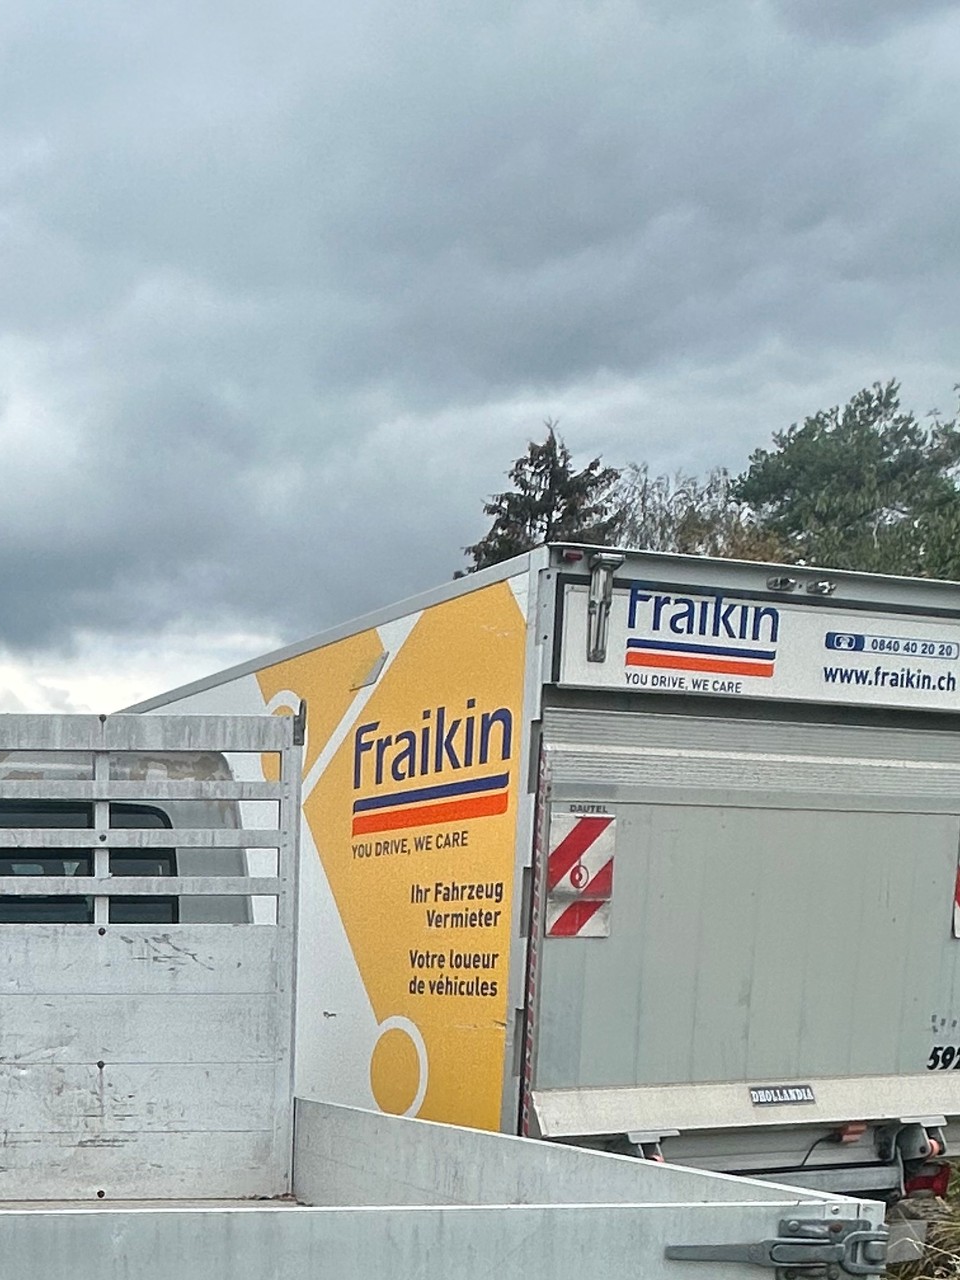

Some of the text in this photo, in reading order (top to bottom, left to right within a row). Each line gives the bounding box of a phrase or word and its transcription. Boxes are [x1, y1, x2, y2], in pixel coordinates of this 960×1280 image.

[627, 581, 780, 643] Fraikin
[871, 638, 953, 656] 0840 40 20 20
[625, 672, 743, 694] YOU DRIVE, WE CARE
[823, 666, 957, 692] www.fraikin.ch
[353, 698, 513, 790] Fraikin
[569, 804, 609, 814] DAUTEL
[352, 830, 469, 860] YOU DRIVE, WE CARE
[411, 881, 504, 904] Ihr Fahrzeug
[426, 907, 502, 929] Vermieter
[409, 948, 500, 970] Votre loueur
[409, 972, 498, 997] de véhicules
[750, 1087, 815, 1104] DHOLLANDIA
